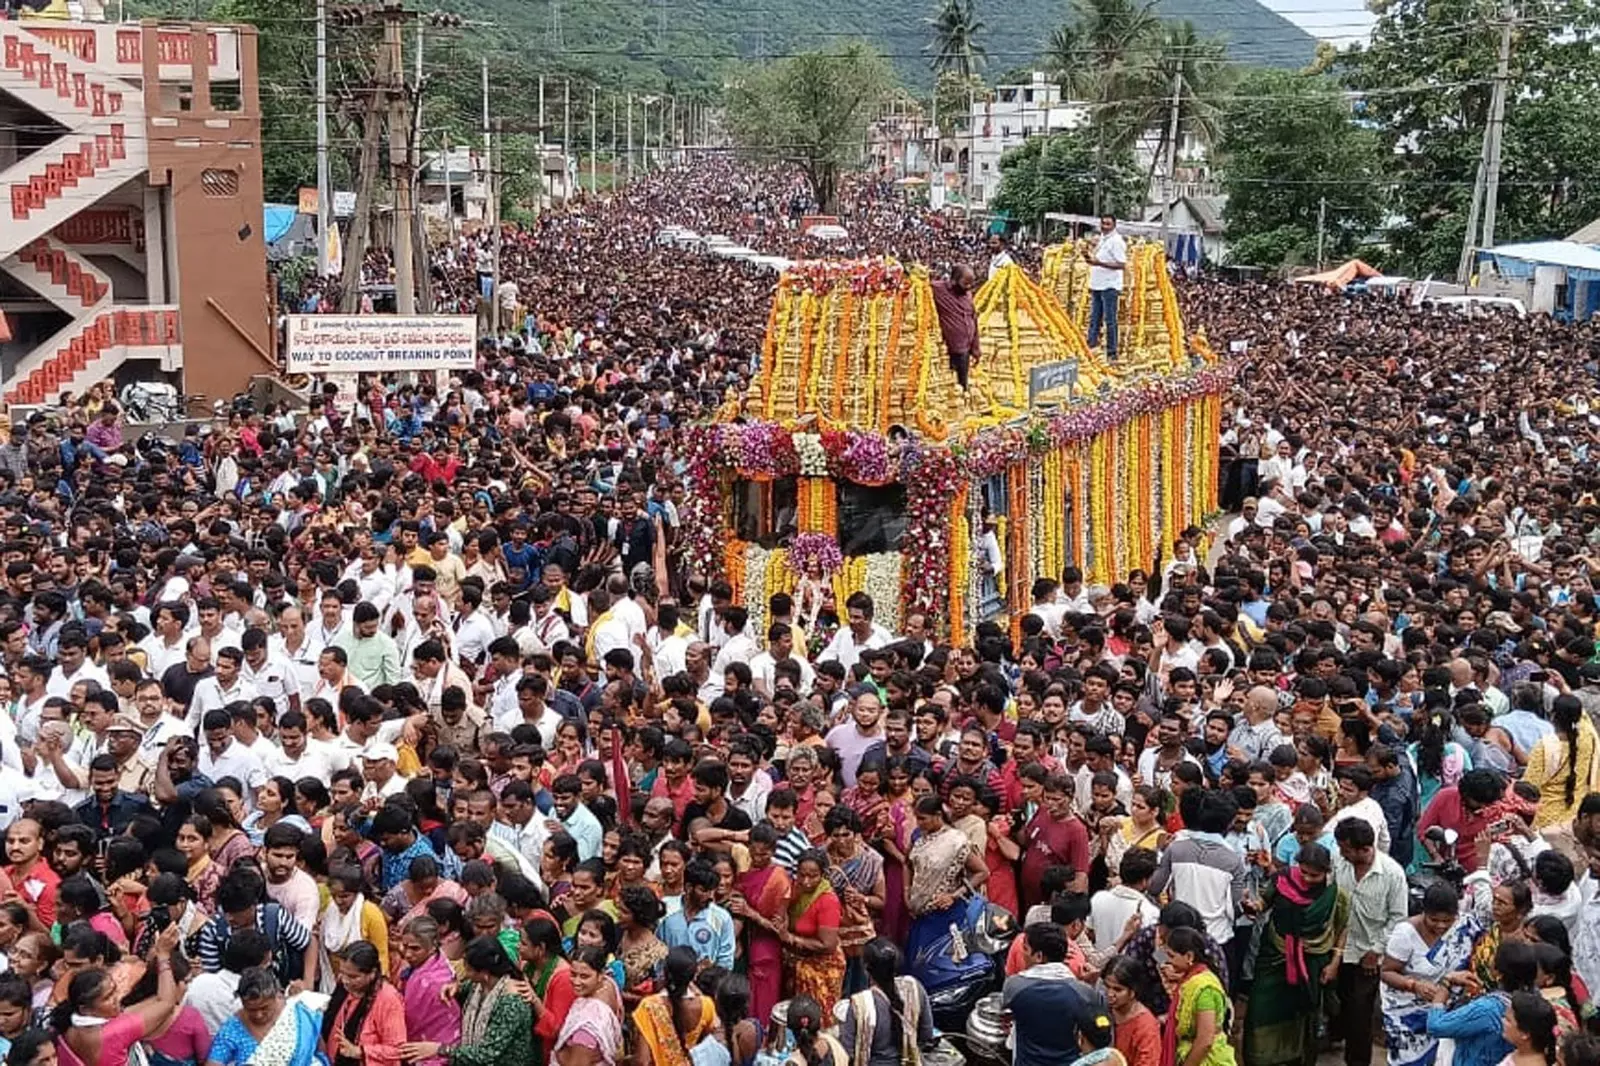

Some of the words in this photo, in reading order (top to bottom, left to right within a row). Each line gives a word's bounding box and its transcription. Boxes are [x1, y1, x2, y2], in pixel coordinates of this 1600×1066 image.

[292, 352, 313, 362] WAY
[320, 352, 332, 361] TO
[336, 351, 384, 361] COCONUT
[388, 350, 440, 360] BREAKING
[443, 348, 472, 359] POINT
